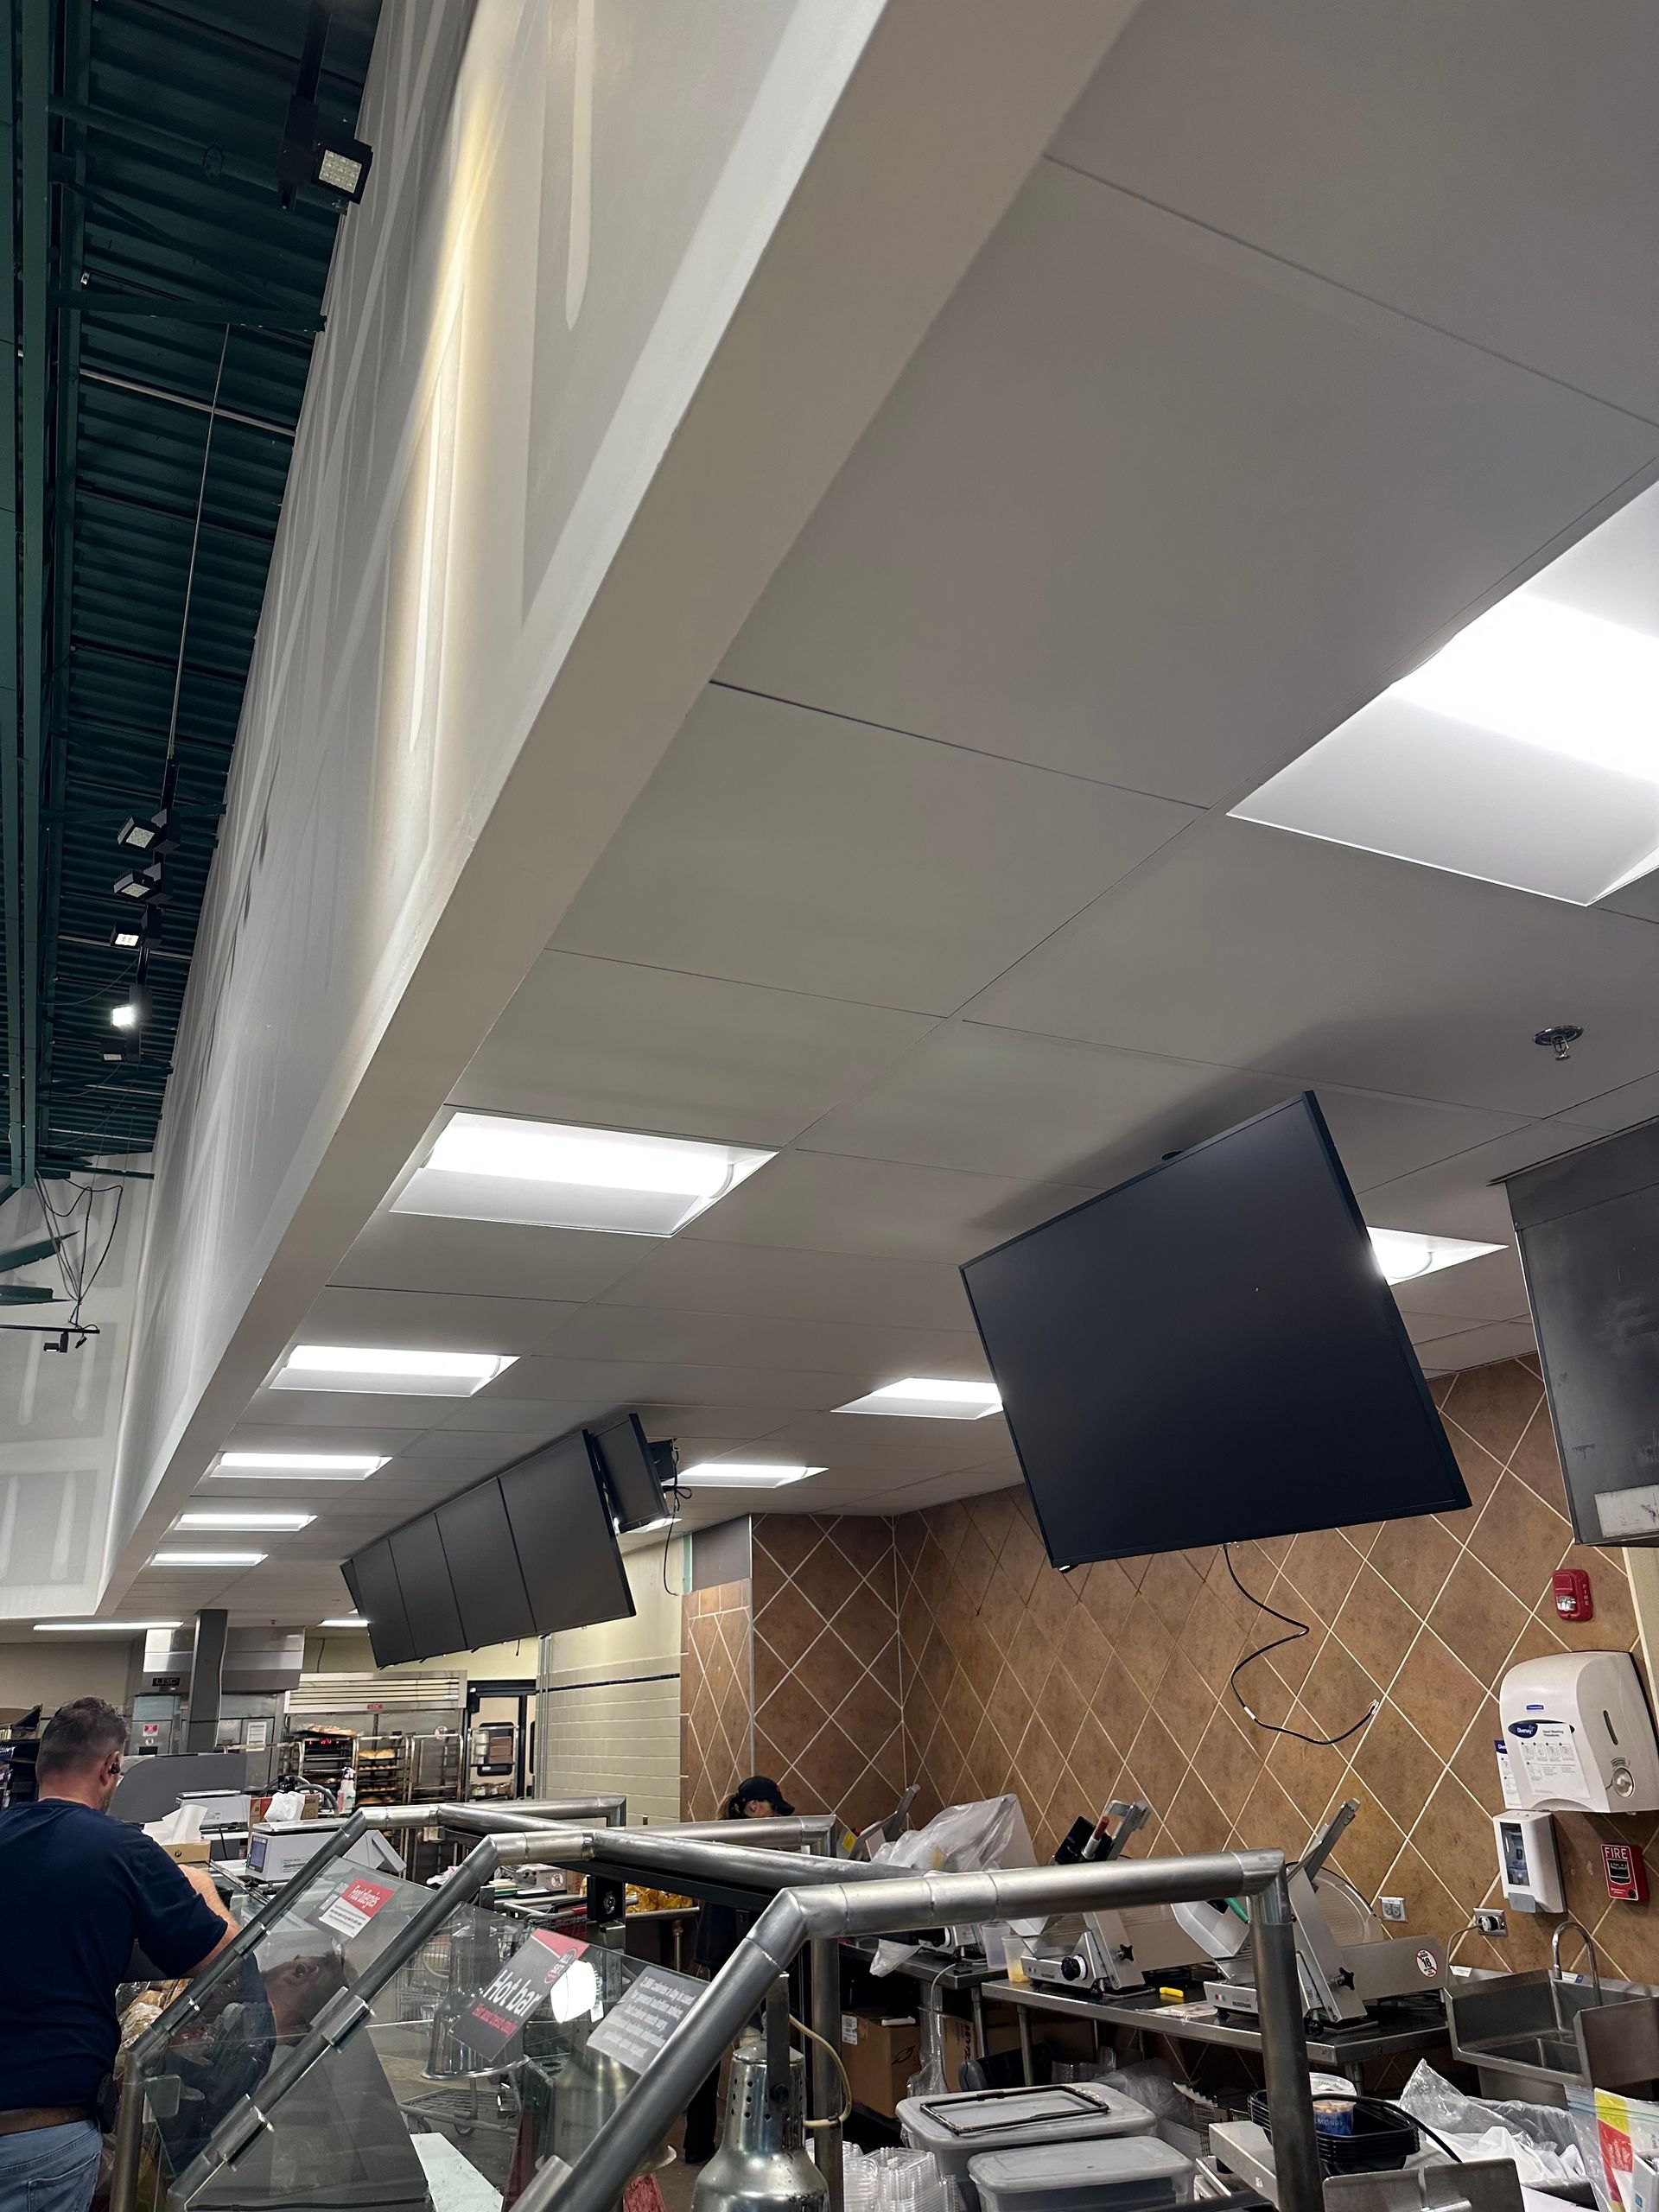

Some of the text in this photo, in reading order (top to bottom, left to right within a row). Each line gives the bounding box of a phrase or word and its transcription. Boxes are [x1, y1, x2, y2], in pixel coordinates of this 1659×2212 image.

[1605, 1847, 1628, 1859] FIRE
[1421, 1957, 1432, 1968] 18
[482, 1969, 543, 2017] Hot bar
[1313, 2117, 1343, 2126] LMONDS
